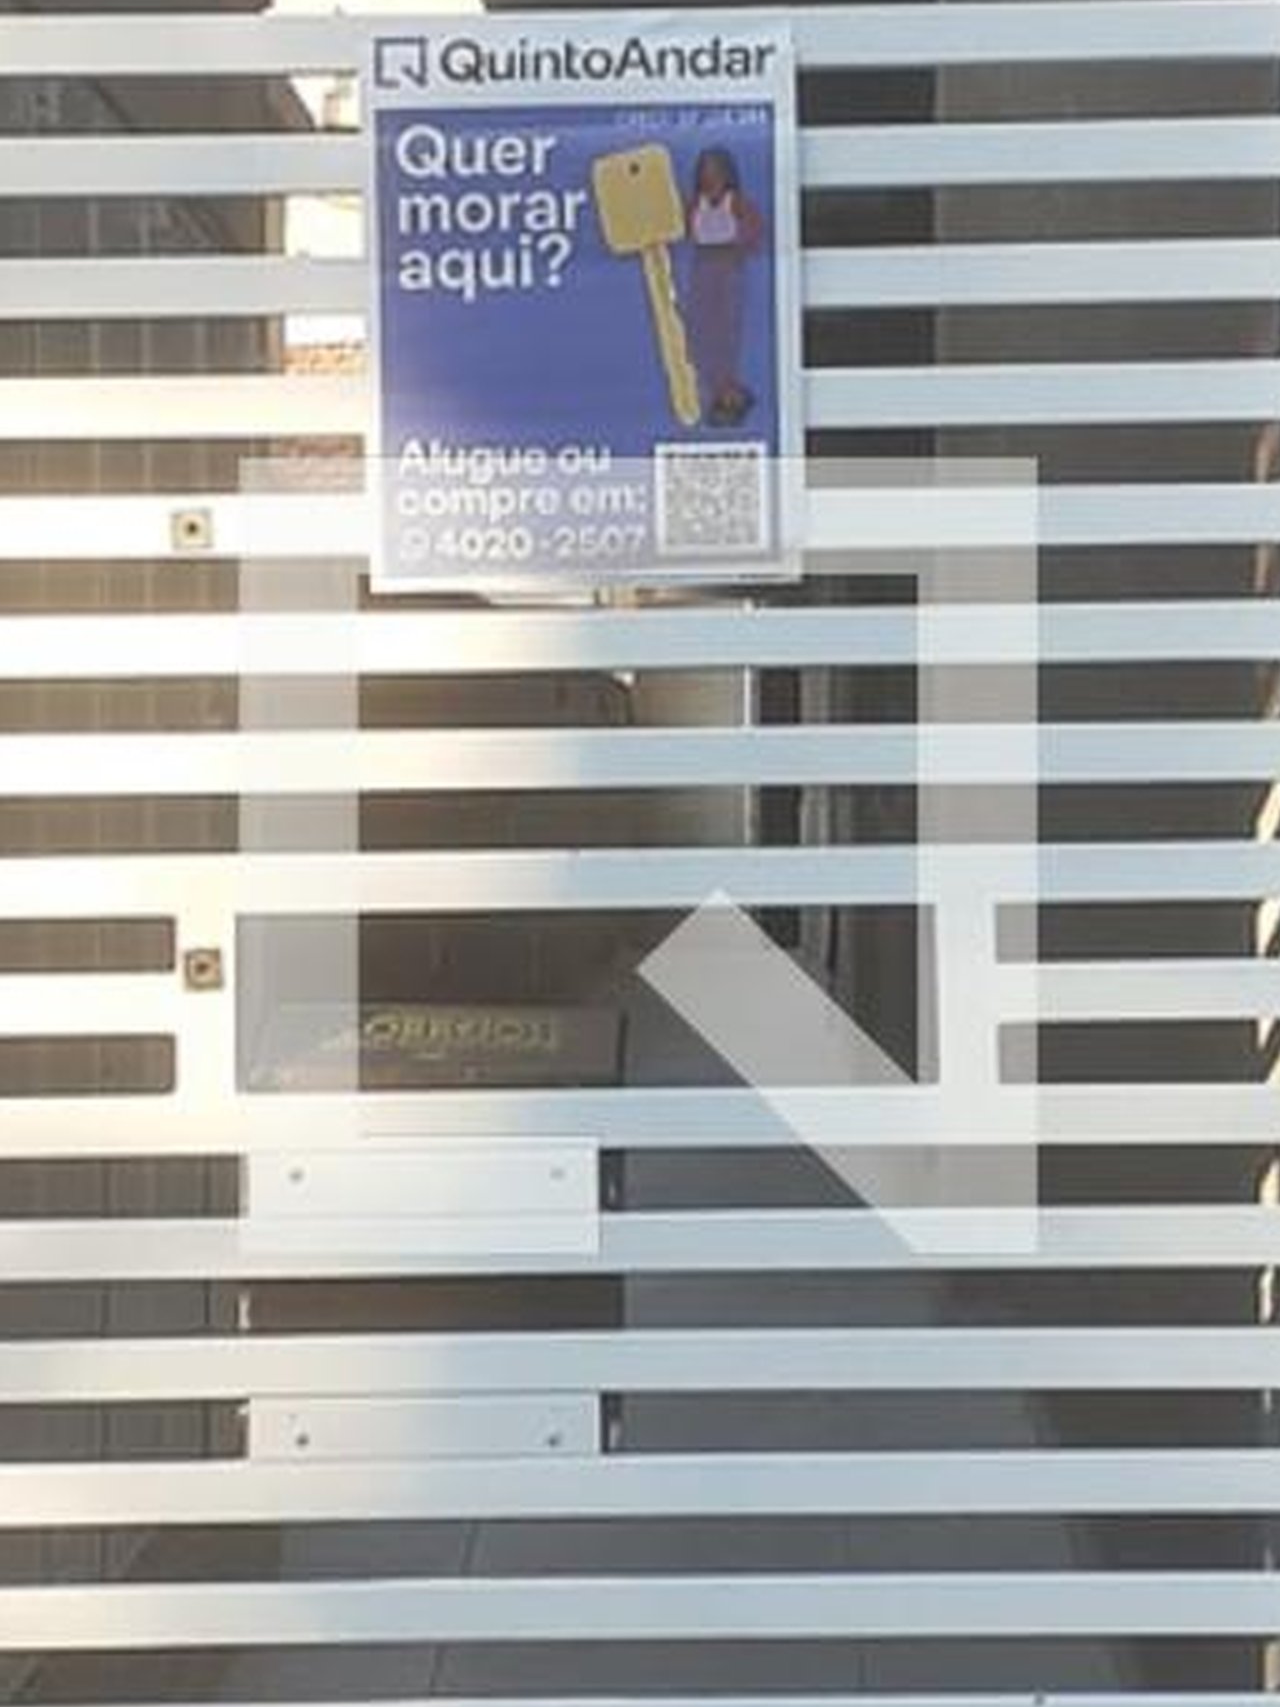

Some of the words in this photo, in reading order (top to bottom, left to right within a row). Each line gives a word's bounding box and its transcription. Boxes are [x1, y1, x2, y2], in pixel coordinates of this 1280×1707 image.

[439, 36, 776, 83] QuintoAndar
[395, 125, 556, 179] Quer
[397, 189, 585, 233] morar
[398, 233, 572, 302] aqui?
[399, 440, 547, 484] Alugue
[557, 444, 611, 477] ou
[398, 485, 561, 522] compre
[569, 484, 649, 516] em:
